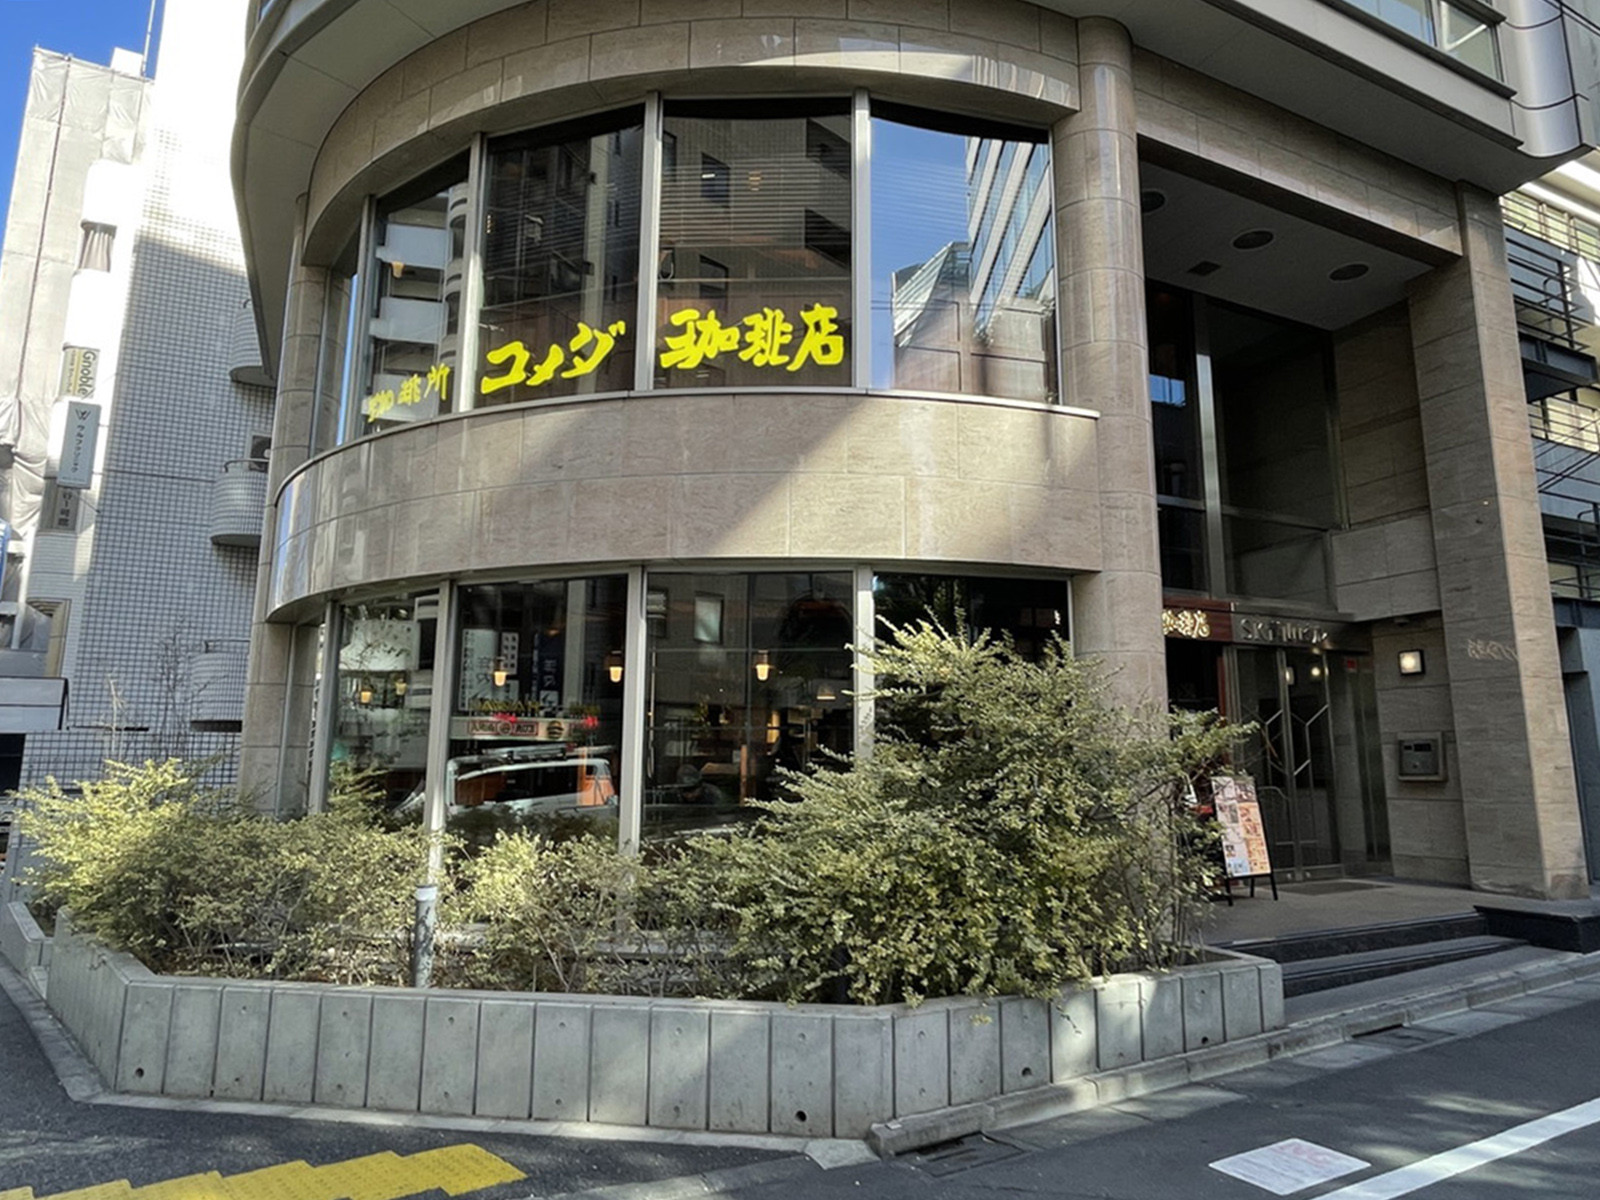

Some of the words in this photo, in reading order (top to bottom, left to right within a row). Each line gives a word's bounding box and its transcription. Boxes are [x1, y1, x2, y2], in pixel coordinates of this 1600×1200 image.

[480, 320, 626, 395] コメダ
[659, 303, 844, 372] 珈琲店
